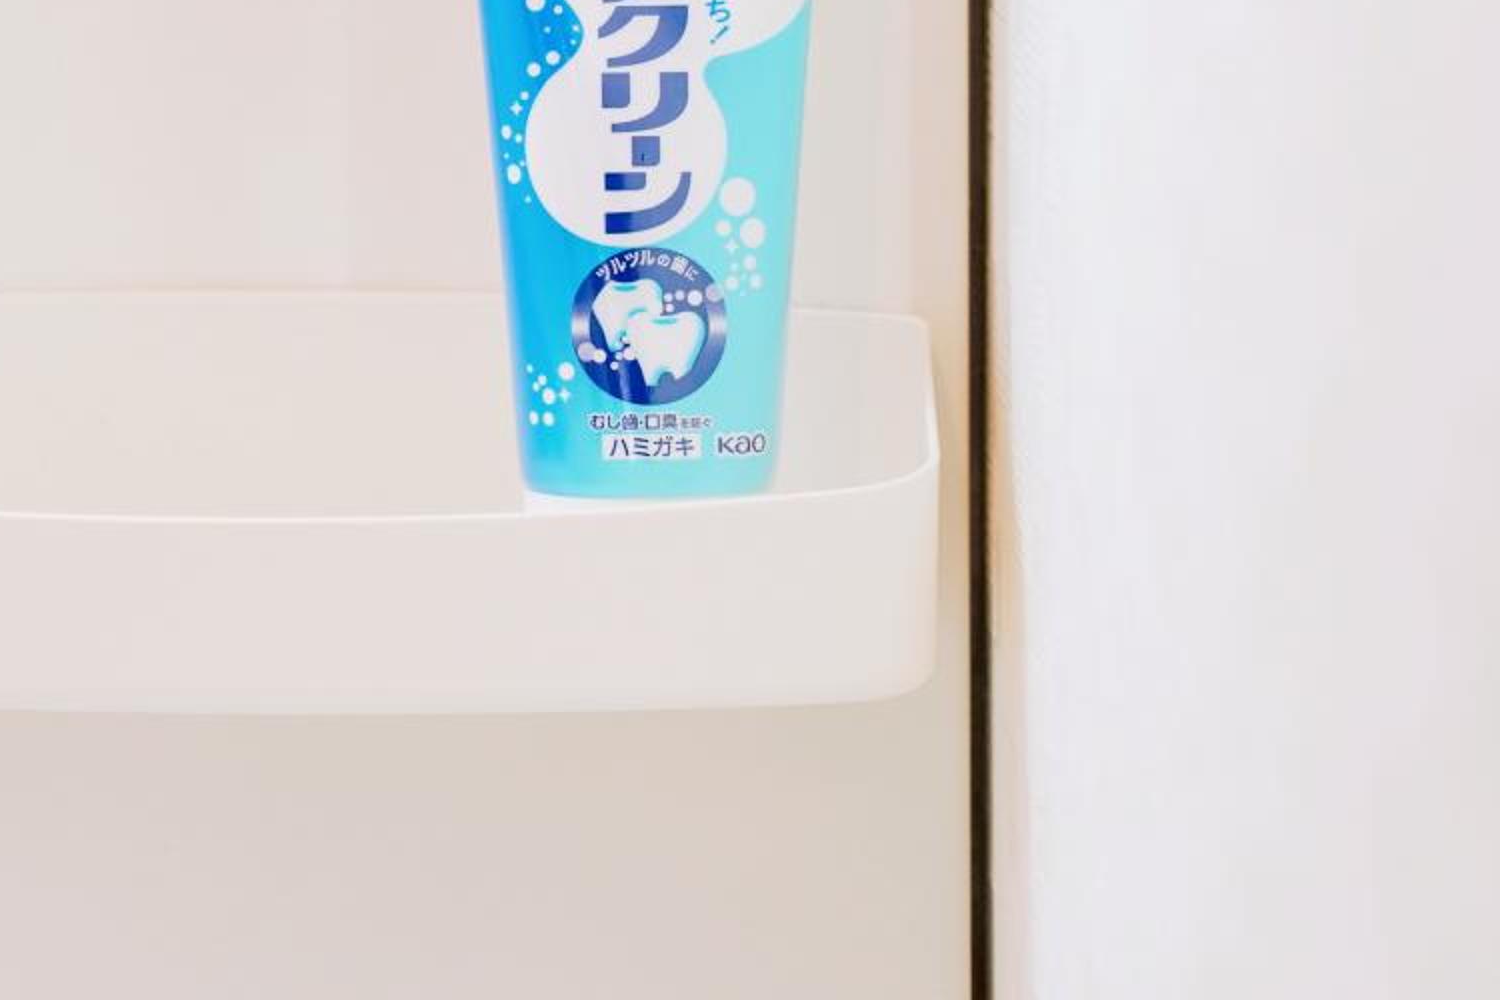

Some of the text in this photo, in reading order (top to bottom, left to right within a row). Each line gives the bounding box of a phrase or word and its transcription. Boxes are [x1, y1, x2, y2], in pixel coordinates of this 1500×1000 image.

[595, 250, 700, 282] ツルツルの歯に
[609, 436, 695, 457] ハミガキ
